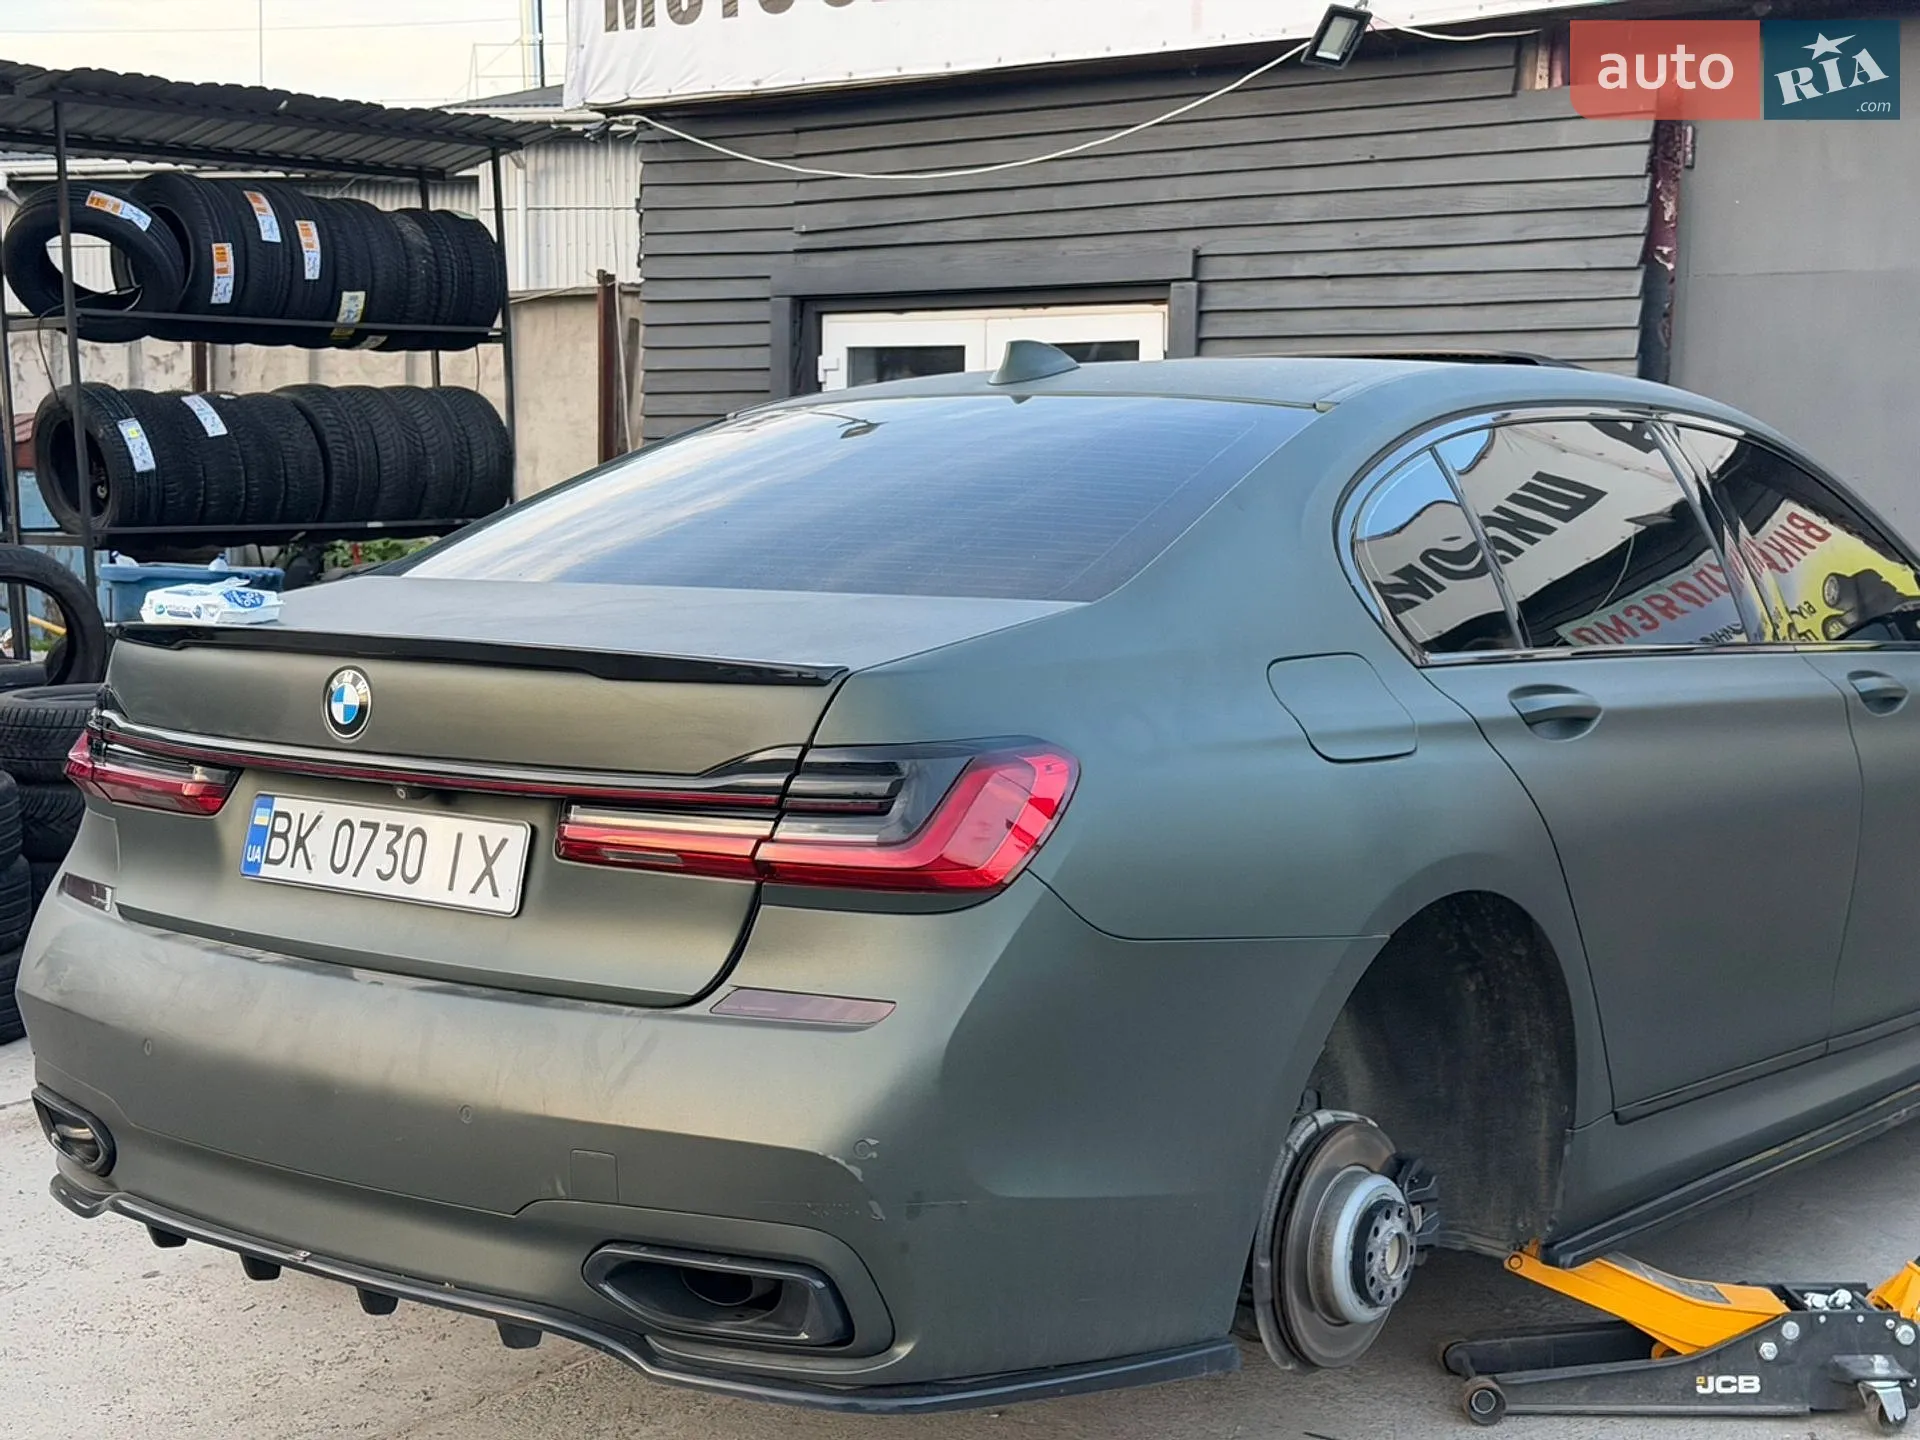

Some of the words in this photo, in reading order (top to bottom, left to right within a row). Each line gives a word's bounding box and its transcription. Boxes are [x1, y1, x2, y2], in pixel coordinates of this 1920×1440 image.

[329, 670, 370, 694] BMW
[246, 844, 262, 864] UA
[264, 810, 323, 871] BK
[329, 818, 428, 885] 0730
[448, 832, 509, 898] IX
[1695, 1375, 1761, 1394] JCB
